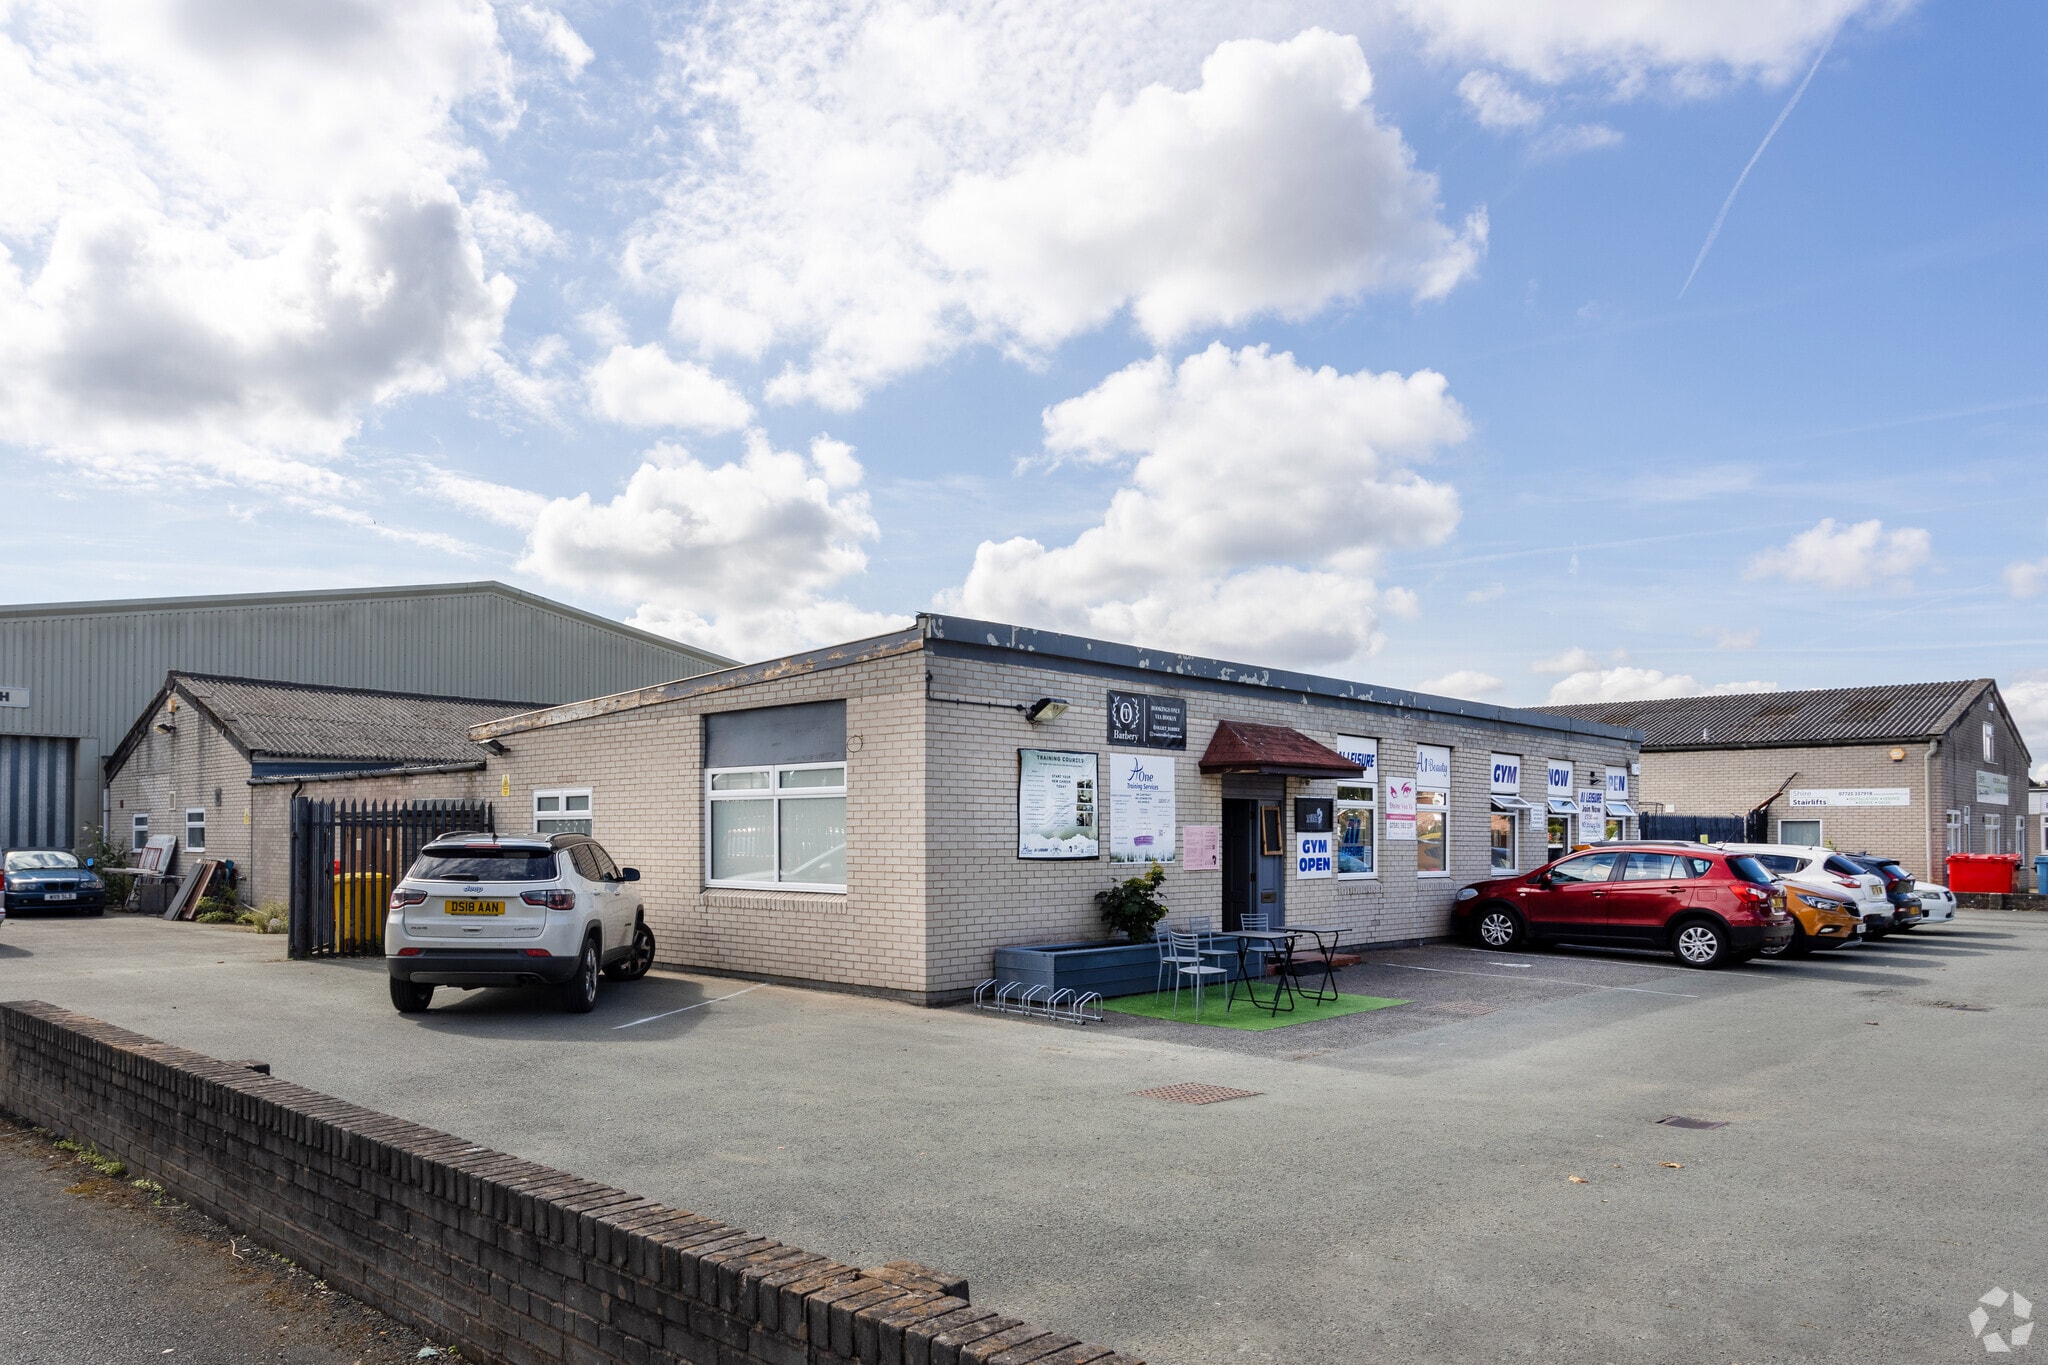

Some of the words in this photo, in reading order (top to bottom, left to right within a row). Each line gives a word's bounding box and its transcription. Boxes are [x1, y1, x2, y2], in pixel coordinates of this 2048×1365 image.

[1113, 729, 1139, 743] Barbery
[1036, 754, 1061, 762] TRAINING
[1428, 758, 1448, 777] Beauty
[1493, 763, 1518, 784] GYM
[1548, 768, 1569, 787] NOW
[1608, 775, 1625, 792] PEN
[1127, 782, 1143, 791] Training
[1585, 792, 1603, 804] LEISURE
[1792, 798, 1827, 806] Stairlifts
[1582, 805, 1591, 813] Join
[1591, 805, 1601, 813] Now
[1302, 839, 1328, 854] GYM
[1299, 857, 1331, 872] OPEN
[463, 885, 484, 893] Jeep
[451, 902, 475, 912] DS18
[477, 902, 499, 913] AAN
